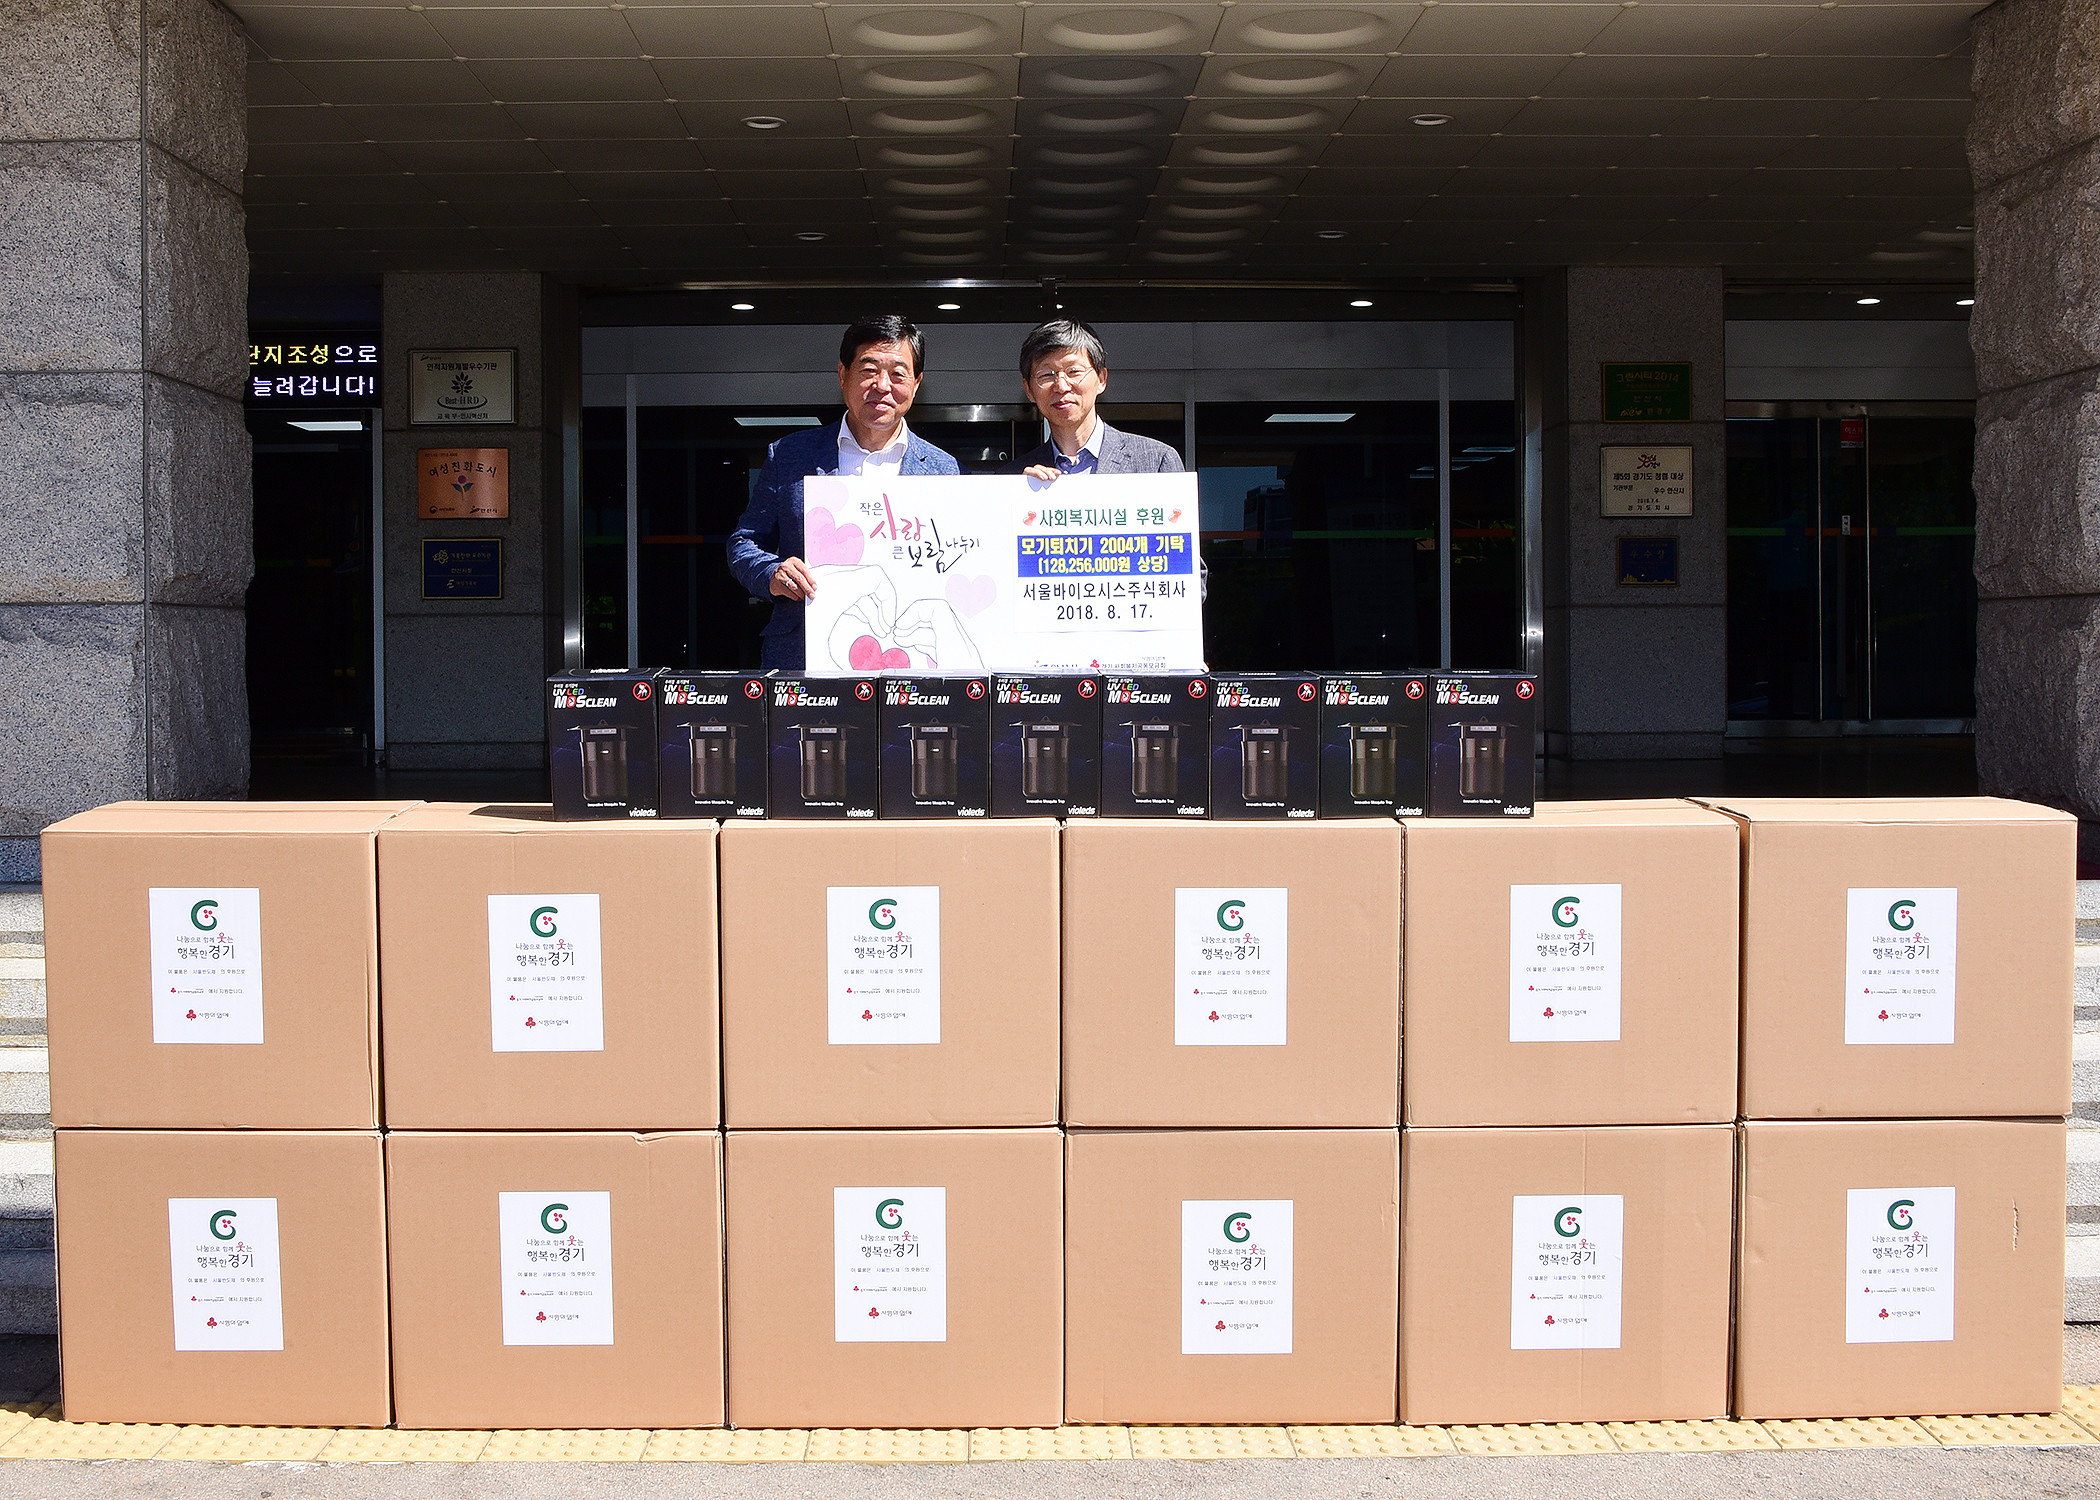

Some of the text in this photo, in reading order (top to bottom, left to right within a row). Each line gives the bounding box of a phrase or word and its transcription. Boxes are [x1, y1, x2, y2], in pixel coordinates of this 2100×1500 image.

[427, 363, 497, 371] 인적자원개발우수기관
[253, 376, 374, 396] 늘려갑니다!
[429, 461, 497, 477] 여성친화도시
[860, 493, 926, 541] 작은 사랑
[1040, 507, 1165, 527] 사회복지시설 후원
[892, 546, 904, 559] 큰
[946, 536, 979, 553] 나누기
[1021, 534, 1184, 556] 모기퇴치기 2004개 기탁
[1023, 582, 1186, 601] 서울바이오시스주식회사
[1057, 604, 1152, 621] 2018. 8. 17.
[553, 688, 566, 696] UV
[885, 685, 899, 693] UV
[997, 683, 1029, 691] UV LED
[1107, 683, 1139, 691] UV LED
[1217, 687, 1230, 695] UV
[1325, 685, 1339, 693] UV
[1436, 684, 1450, 692] UV
[629, 807, 656, 817] violeds
[737, 806, 764, 816] violeds
[847, 807, 874, 817] violeds
[958, 806, 985, 816] violeds
[1068, 805, 1095, 815] violeds
[1177, 805, 1204, 815] violeds
[1288, 808, 1314, 818] violeds
[1395, 806, 1422, 816] violeds
[1504, 805, 1530, 814] violeds
[217, 932, 233, 943] 웃는
[895, 931, 912, 942] 웃는
[1243, 933, 1260, 943] 웃는
[1578, 929, 1594, 940] 웃는
[1913, 932, 1929, 943] 웃는
[557, 939, 573, 950] 웃는
[567, 1235, 584, 1246] 웃는
[902, 1231, 918, 1242] 웃는
[1912, 1231, 1928, 1242] 웃는
[236, 1242, 252, 1252] 웃는
[1579, 1239, 1595, 1249] 웃는
[1249, 1244, 1265, 1255] 웃는
